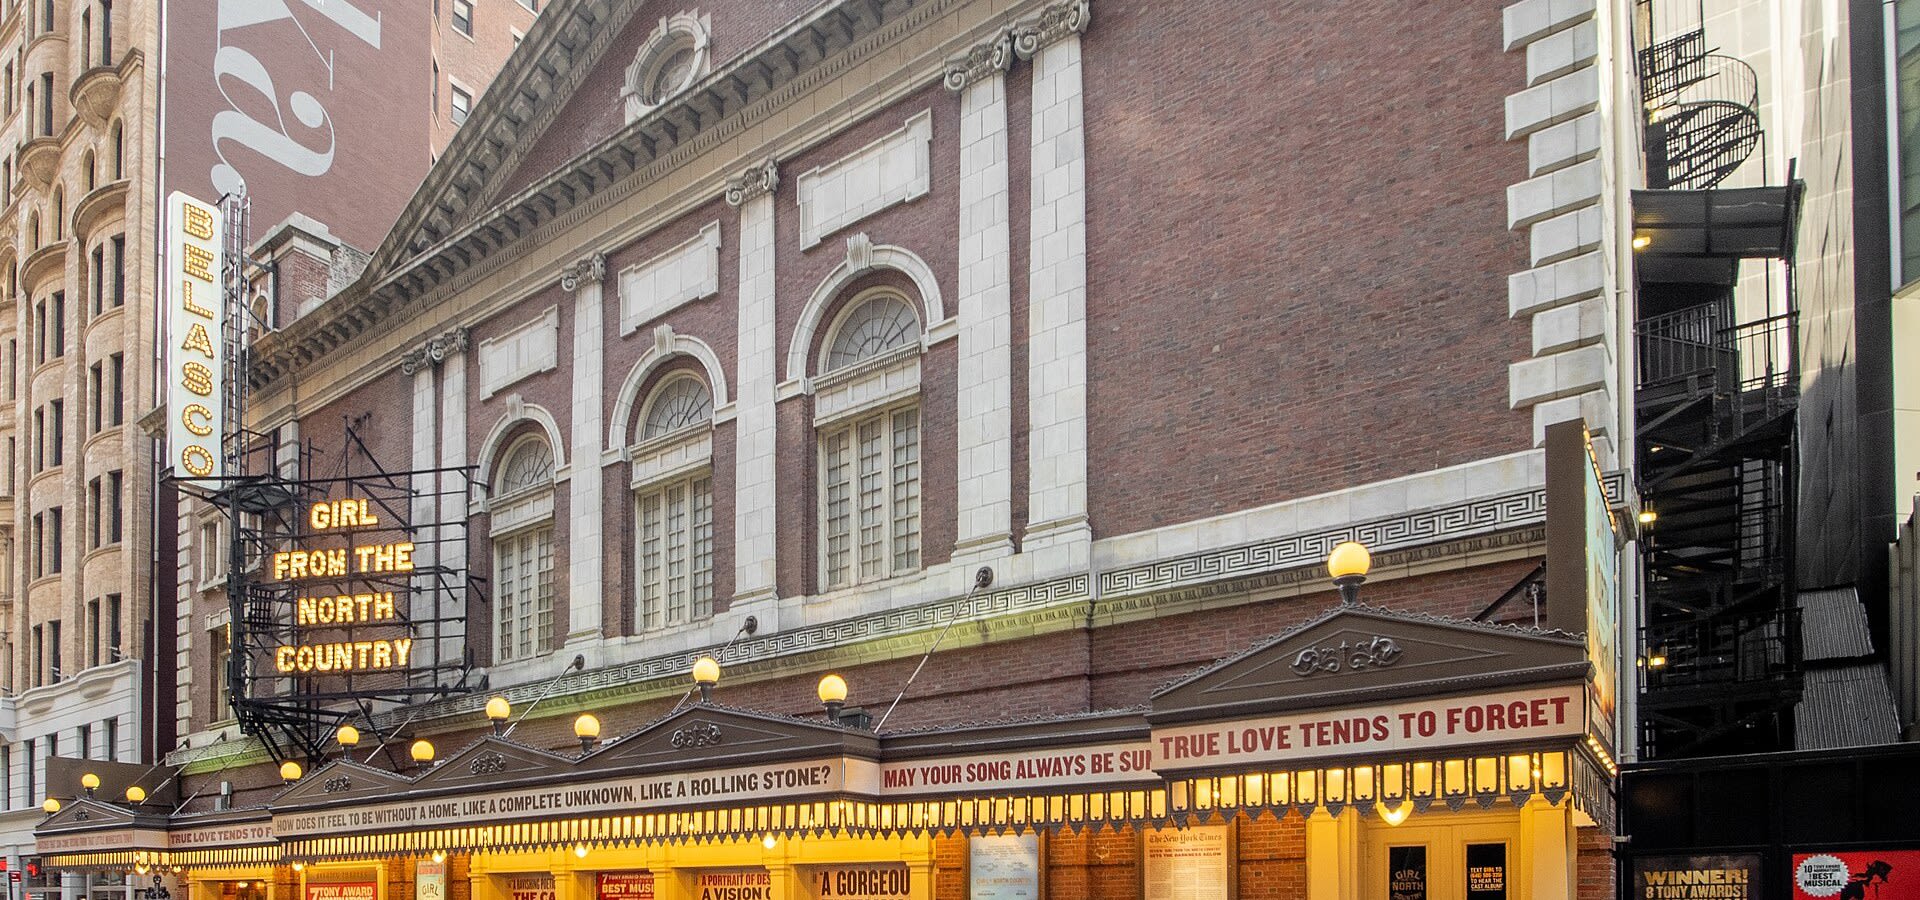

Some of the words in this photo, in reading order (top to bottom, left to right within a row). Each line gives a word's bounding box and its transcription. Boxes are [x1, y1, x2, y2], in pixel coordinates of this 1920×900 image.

[181, 203, 214, 476] BELASCO
[310, 498, 379, 530] GIRL
[273, 549, 347, 580] FROM
[355, 542, 415, 573] THE
[298, 592, 394, 625] NORTH
[276, 638, 412, 672] COUNTRY
[1160, 732, 1220, 760] TRUE
[1228, 725, 1291, 754] LOVE
[1299, 715, 1389, 747] TENDS
[1399, 711, 1436, 739] TO
[1446, 696, 1570, 735] FORGET
[884, 768, 916, 788] MAY
[920, 765, 962, 785] YOUR
[966, 761, 1011, 782] SONG
[1015, 754, 1086, 779] ALWAYS
[1091, 752, 1114, 774] BE
[277, 819, 294, 832] HOW
[296, 817, 316, 829] DOES
[318, 816, 325, 828] IT
[327, 813, 347, 828] FEEL
[349, 812, 360, 826] TO
[362, 811, 373, 825] BE
[374, 807, 417, 824] WITHOUT
[420, 806, 426, 819] A
[429, 803, 461, 819] HOME,
[462, 800, 486, 816] LIKE
[489, 799, 496, 814] A
[499, 793, 562, 813] COMPLETE
[565, 785, 637, 807] UNKNOWN,
[640, 782, 672, 801] LIKE
[677, 781, 686, 798] A
[691, 773, 759, 796] ROLLING
[763, 765, 831, 790] STONE?
[170, 834, 192, 844] TRUE
[193, 832, 217, 842] LOVE
[218, 827, 249, 841] TENDS
[250, 827, 263, 838] TO
[1150, 834, 1162, 843] The
[1163, 834, 1178, 843] New
[1179, 833, 1198, 844] York
[1199, 832, 1222, 841] Times
[1395, 869, 1420, 880] GIRL
[1804, 865, 1812, 873] 10
[702, 875, 706, 886] A
[708, 874, 743, 886] PORTRAIT
[746, 874, 755, 885] OF
[837, 869, 910, 896] GORGEOU
[1644, 869, 1748, 885] WINNER!
[310, 887, 323, 900] 7
[319, 887, 340, 897] TONY
[343, 886, 373, 897] AWARD
[422, 883, 438, 896] GIRL
[602, 884, 626, 893] BEST
[702, 888, 711, 900] A
[714, 887, 762, 900] VISION
[1392, 881, 1424, 891] NORTH
[1646, 886, 1654, 898] 8
[1656, 886, 1688, 898] TONY
[513, 892, 537, 900] THE
